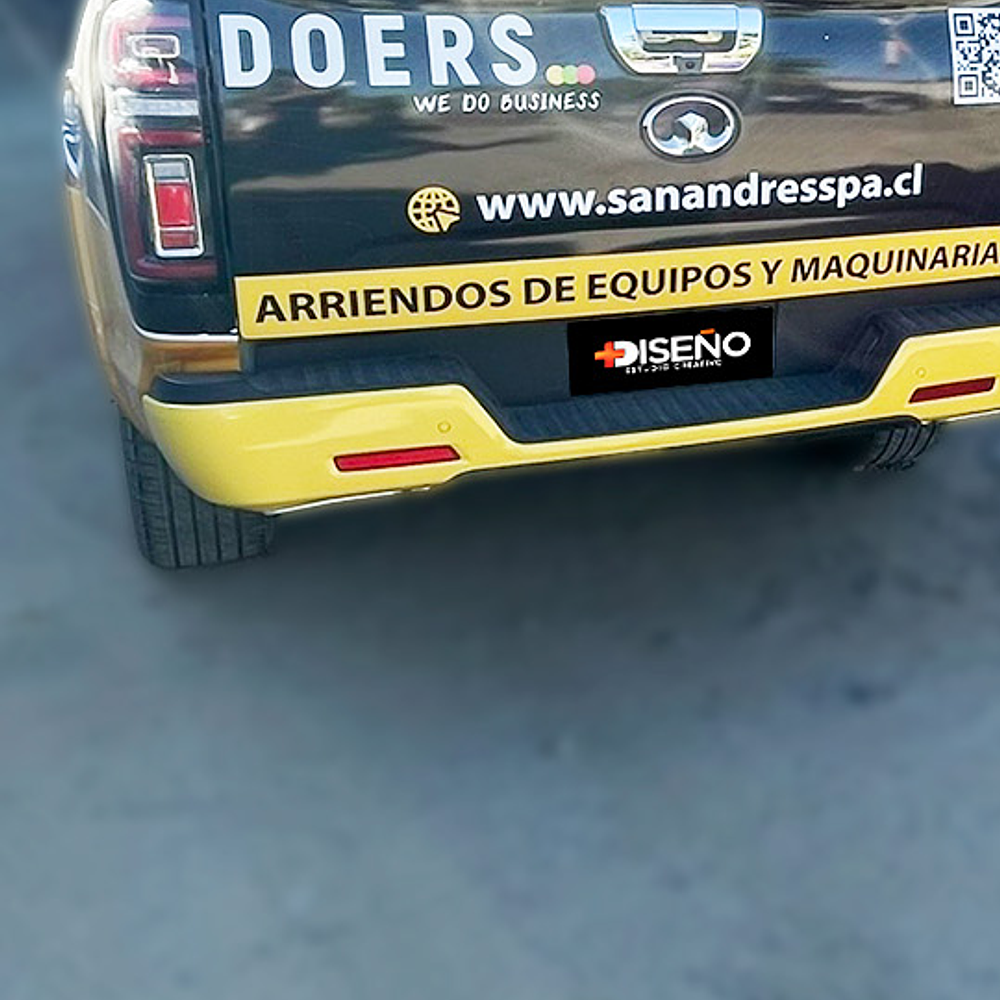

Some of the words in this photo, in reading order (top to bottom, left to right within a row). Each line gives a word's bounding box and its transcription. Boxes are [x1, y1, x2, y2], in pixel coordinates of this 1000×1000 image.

[218, 12, 539, 89] DOERS
[413, 93, 451, 114] WE
[462, 93, 489, 113] DO
[500, 90, 601, 113] BUSINESS
[476, 162, 924, 222] www.sanandresspa.cl
[255, 279, 511, 323] ARRIENDOS
[524, 275, 576, 306] DE
[587, 260, 752, 301] EQUIPOS
[761, 259, 784, 285] Y
